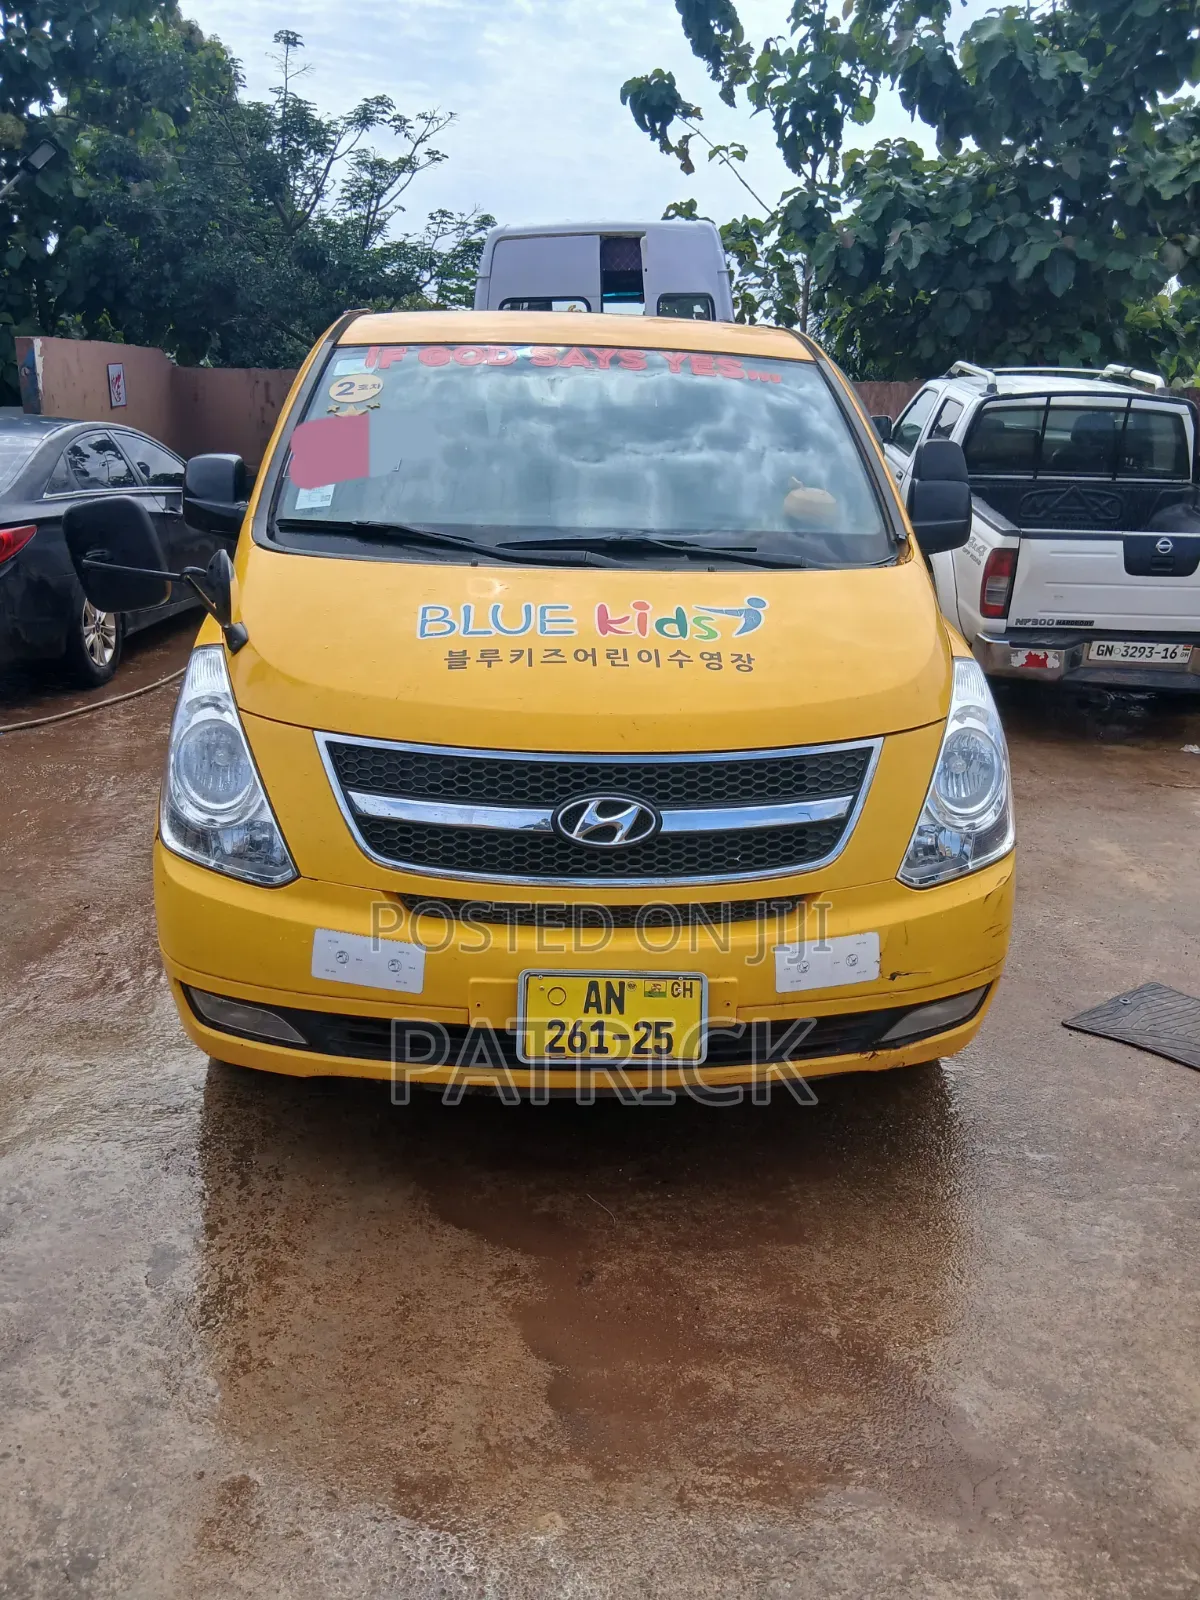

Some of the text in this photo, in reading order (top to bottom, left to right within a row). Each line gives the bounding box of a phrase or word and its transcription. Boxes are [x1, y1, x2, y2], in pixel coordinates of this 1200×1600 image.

[364, 346, 407, 369] IF
[418, 346, 518, 367] GOD
[529, 347, 648, 370] SAYS
[415, 599, 721, 641] BLUE kids
[1014, 618, 1055, 626] NP300
[443, 648, 756, 673] 블루키즈어린이수영장
[1096, 644, 1114, 656] GN
[1120, 645, 1178, 660] 3293-16
[583, 980, 694, 1015] AN GH
[545, 1019, 675, 1055] 261-25
